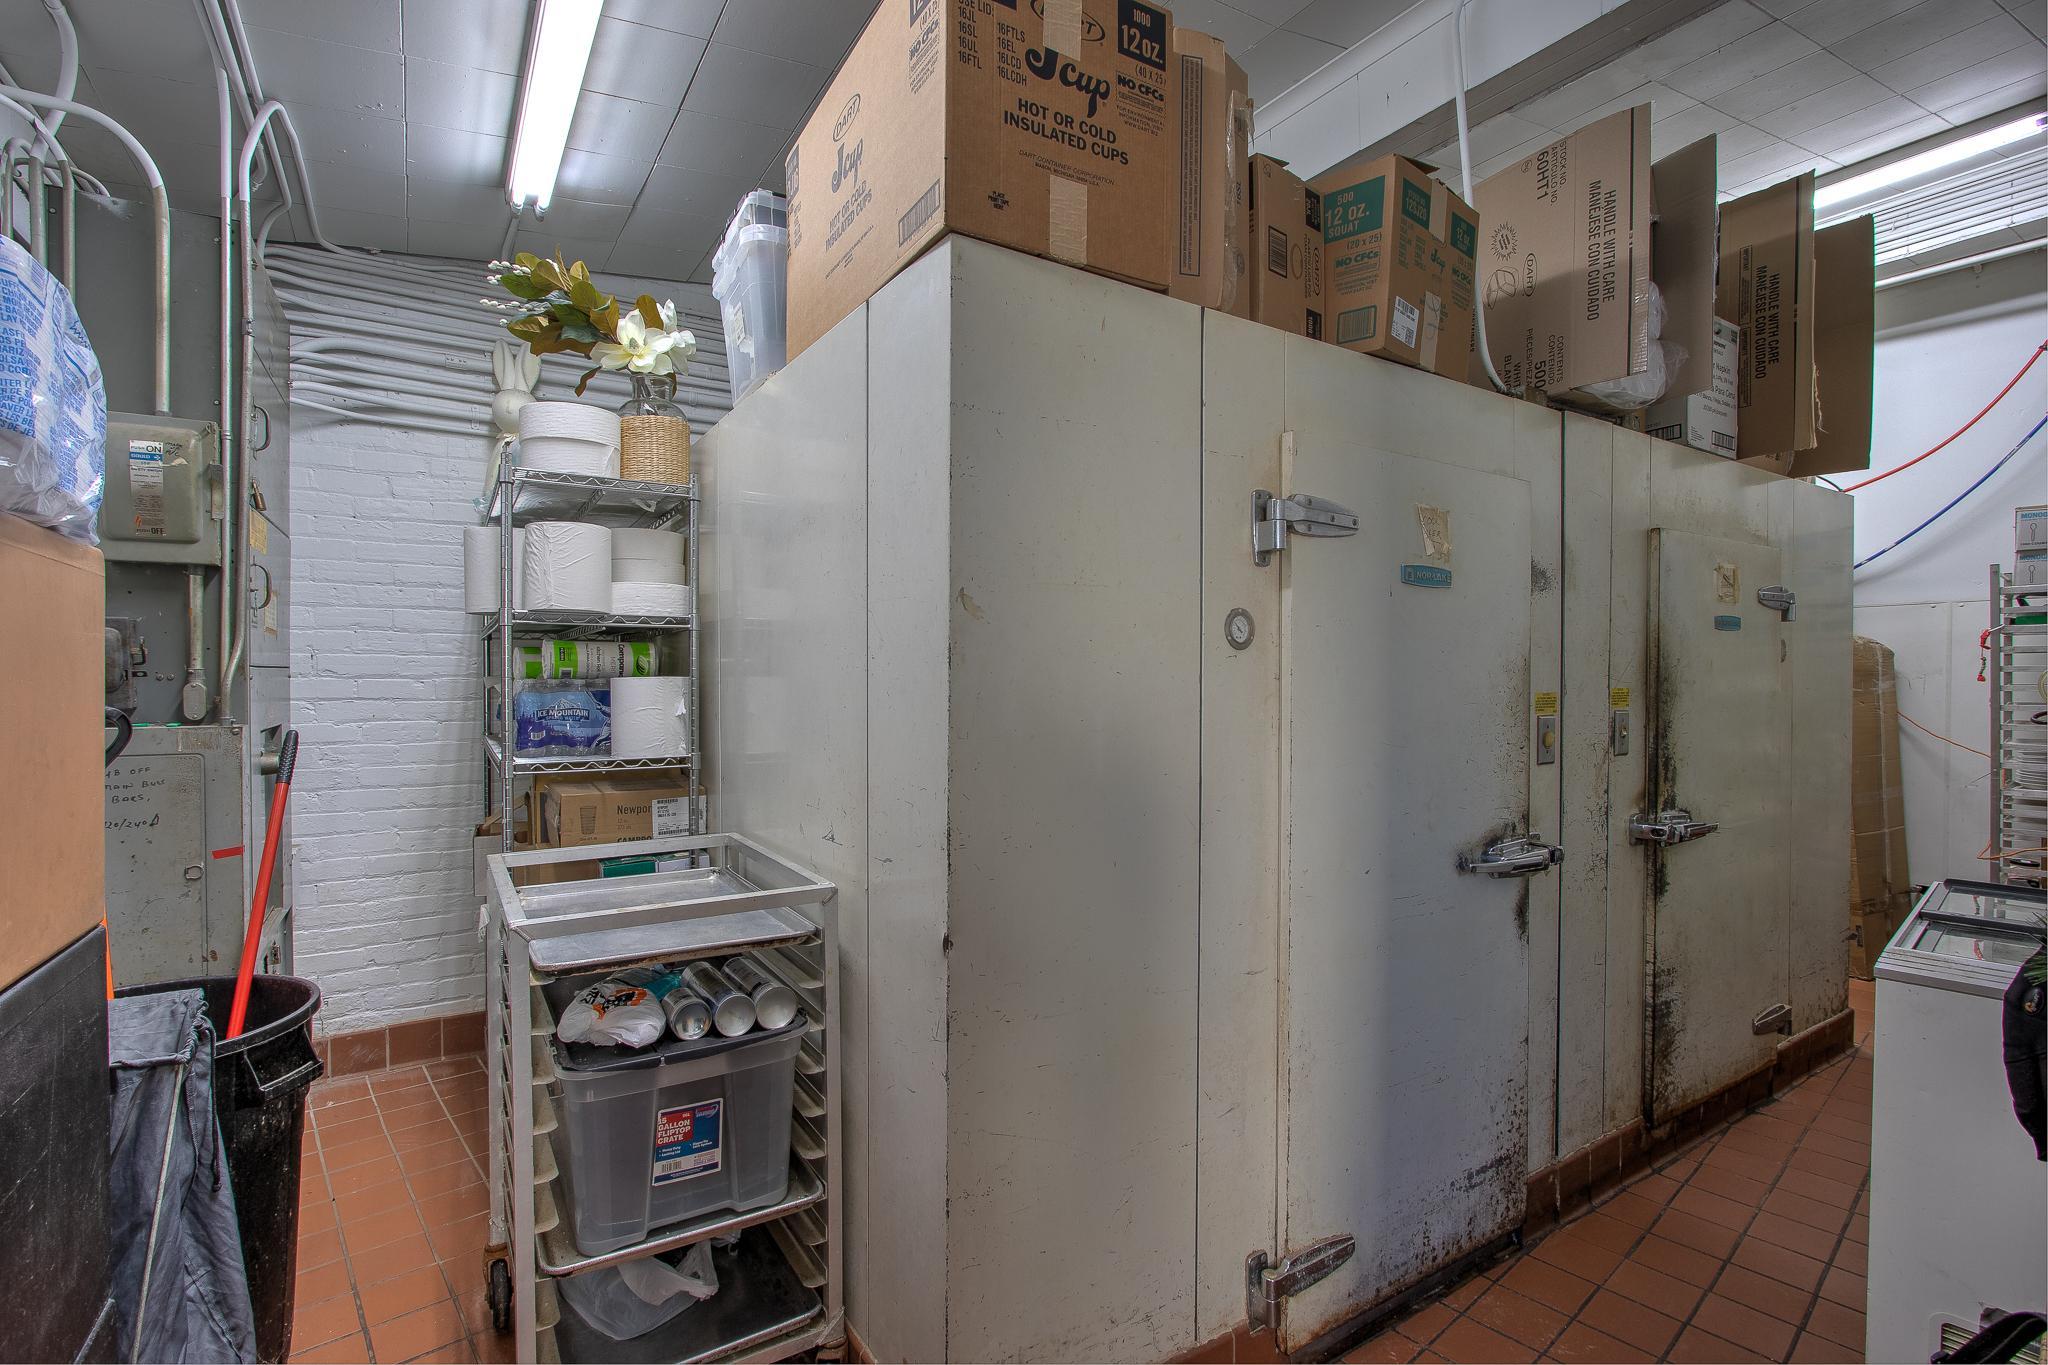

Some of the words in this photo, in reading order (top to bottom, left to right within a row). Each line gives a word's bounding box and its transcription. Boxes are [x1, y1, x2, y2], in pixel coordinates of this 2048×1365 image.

[959, 7, 976, 24] 16JL
[1133, 9, 1151, 27] 1000
[959, 21, 978, 39] 16SL
[998, 22, 1026, 43] 16FTLS
[959, 36, 978, 53] 16UL
[998, 37, 1016, 54] 16EL
[959, 51, 982, 70] 16FTL
[998, 52, 1021, 70] 16LCD
[998, 66, 1027, 86] 16LCDH
[1117, 74, 1137, 91] NO
[1138, 82, 1165, 102] CFCs
[835, 97, 859, 138] DART
[1018, 98, 1049, 120] HOT
[1053, 111, 1074, 130] OR
[1078, 120, 1117, 145] COLD
[1004, 110, 1087, 151] INSULATED
[1091, 142, 1129, 166] CUPS
[1559, 139, 1567, 171] STOCK
[1536, 150, 1549, 200] 60HT1
[1550, 145, 1559, 188] ARTICULO
[1336, 191, 1354, 206] 500
[1325, 206, 1343, 227] 12
[1603, 189, 1616, 236] HANDLE
[1328, 220, 1359, 239] SQUAT
[1335, 256, 1352, 269] NO
[1354, 250, 1380, 264] CFCs
[1588, 243, 1600, 268] CON
[1603, 239, 1616, 267] WITH
[1525, 259, 1534, 292] DART
[1602, 268, 1615, 304] CARE
[1587, 269, 1600, 321] CUIDADO
[1768, 273, 1780, 310] HANDLE
[1755, 316, 1766, 337] CON
[1768, 313, 1780, 334] WITH
[0, 353, 25, 366] OLSA
[1526, 327, 1534, 386] PIECES/PIEZA
[1548, 334, 1556, 385] CONTENIDO
[1556, 335, 1565, 383] CONTENTS
[1754, 338, 1766, 380] CUIDADO
[1767, 335, 1779, 365] CARE
[1504, 355, 1512, 390] BLANC
[1513, 361, 1521, 388] WHIT
[146, 445, 162, 454] ON
[151, 527, 166, 535] OFF
[537, 710, 548, 718] ICE
[548, 709, 589, 718] MOUNTAIN
[617, 804, 652, 815] Newpor
[658, 1117, 667, 1125] 15
[658, 1119, 691, 1131] GALLON
[658, 1125, 691, 1138] FLIPTOP
[657, 1133, 684, 1145] CRATE
